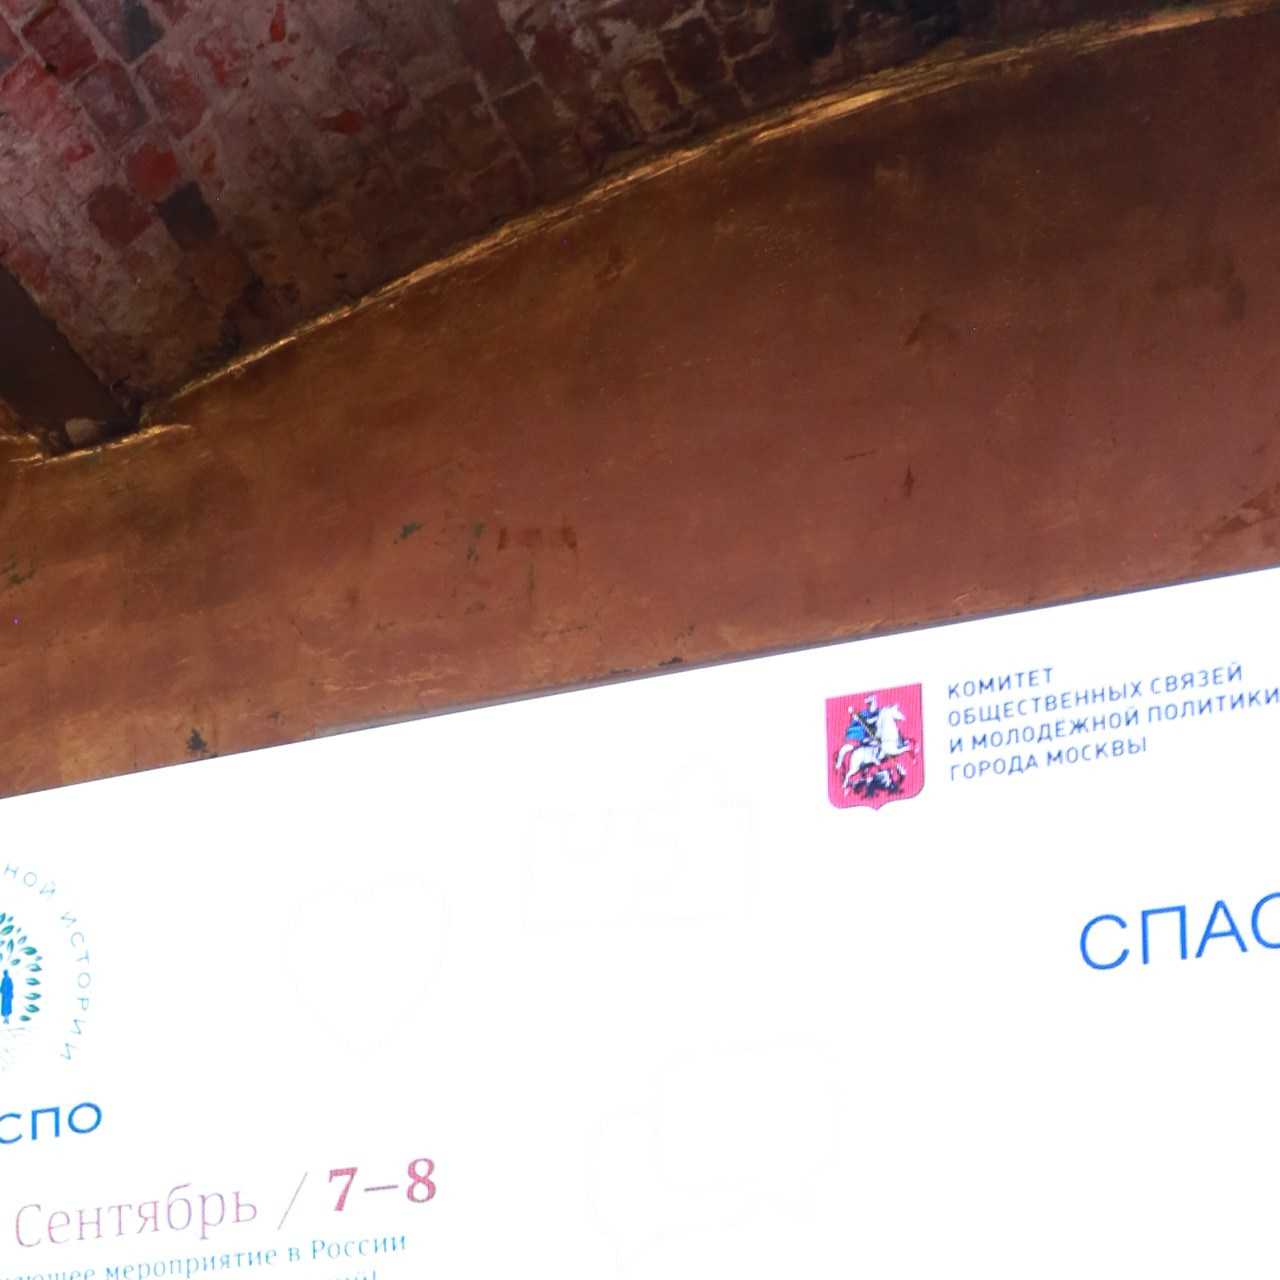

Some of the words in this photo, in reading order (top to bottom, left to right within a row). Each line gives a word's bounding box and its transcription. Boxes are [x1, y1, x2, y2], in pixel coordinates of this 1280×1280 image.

[948, 667, 1053, 700] КОМИТЕТ
[948, 680, 1142, 727] ОБЩЕСТВЕННЫХ
[1150, 660, 1242, 695] СВЯЗЕЙ
[949, 737, 963, 754] И
[1148, 687, 1280, 723] ПОЛИТИКИ
[950, 754, 1039, 781] ГОРОДА
[1046, 736, 1146, 767] МОСКВЫ
[1079, 891, 1280, 971] СПАС
[59, 910, 91, 1062] ИСТОРИИ
[15, 1182, 258, 1248] Сентябрь
[288, 1246, 301, 1263] в
[311, 1234, 407, 1260] России
